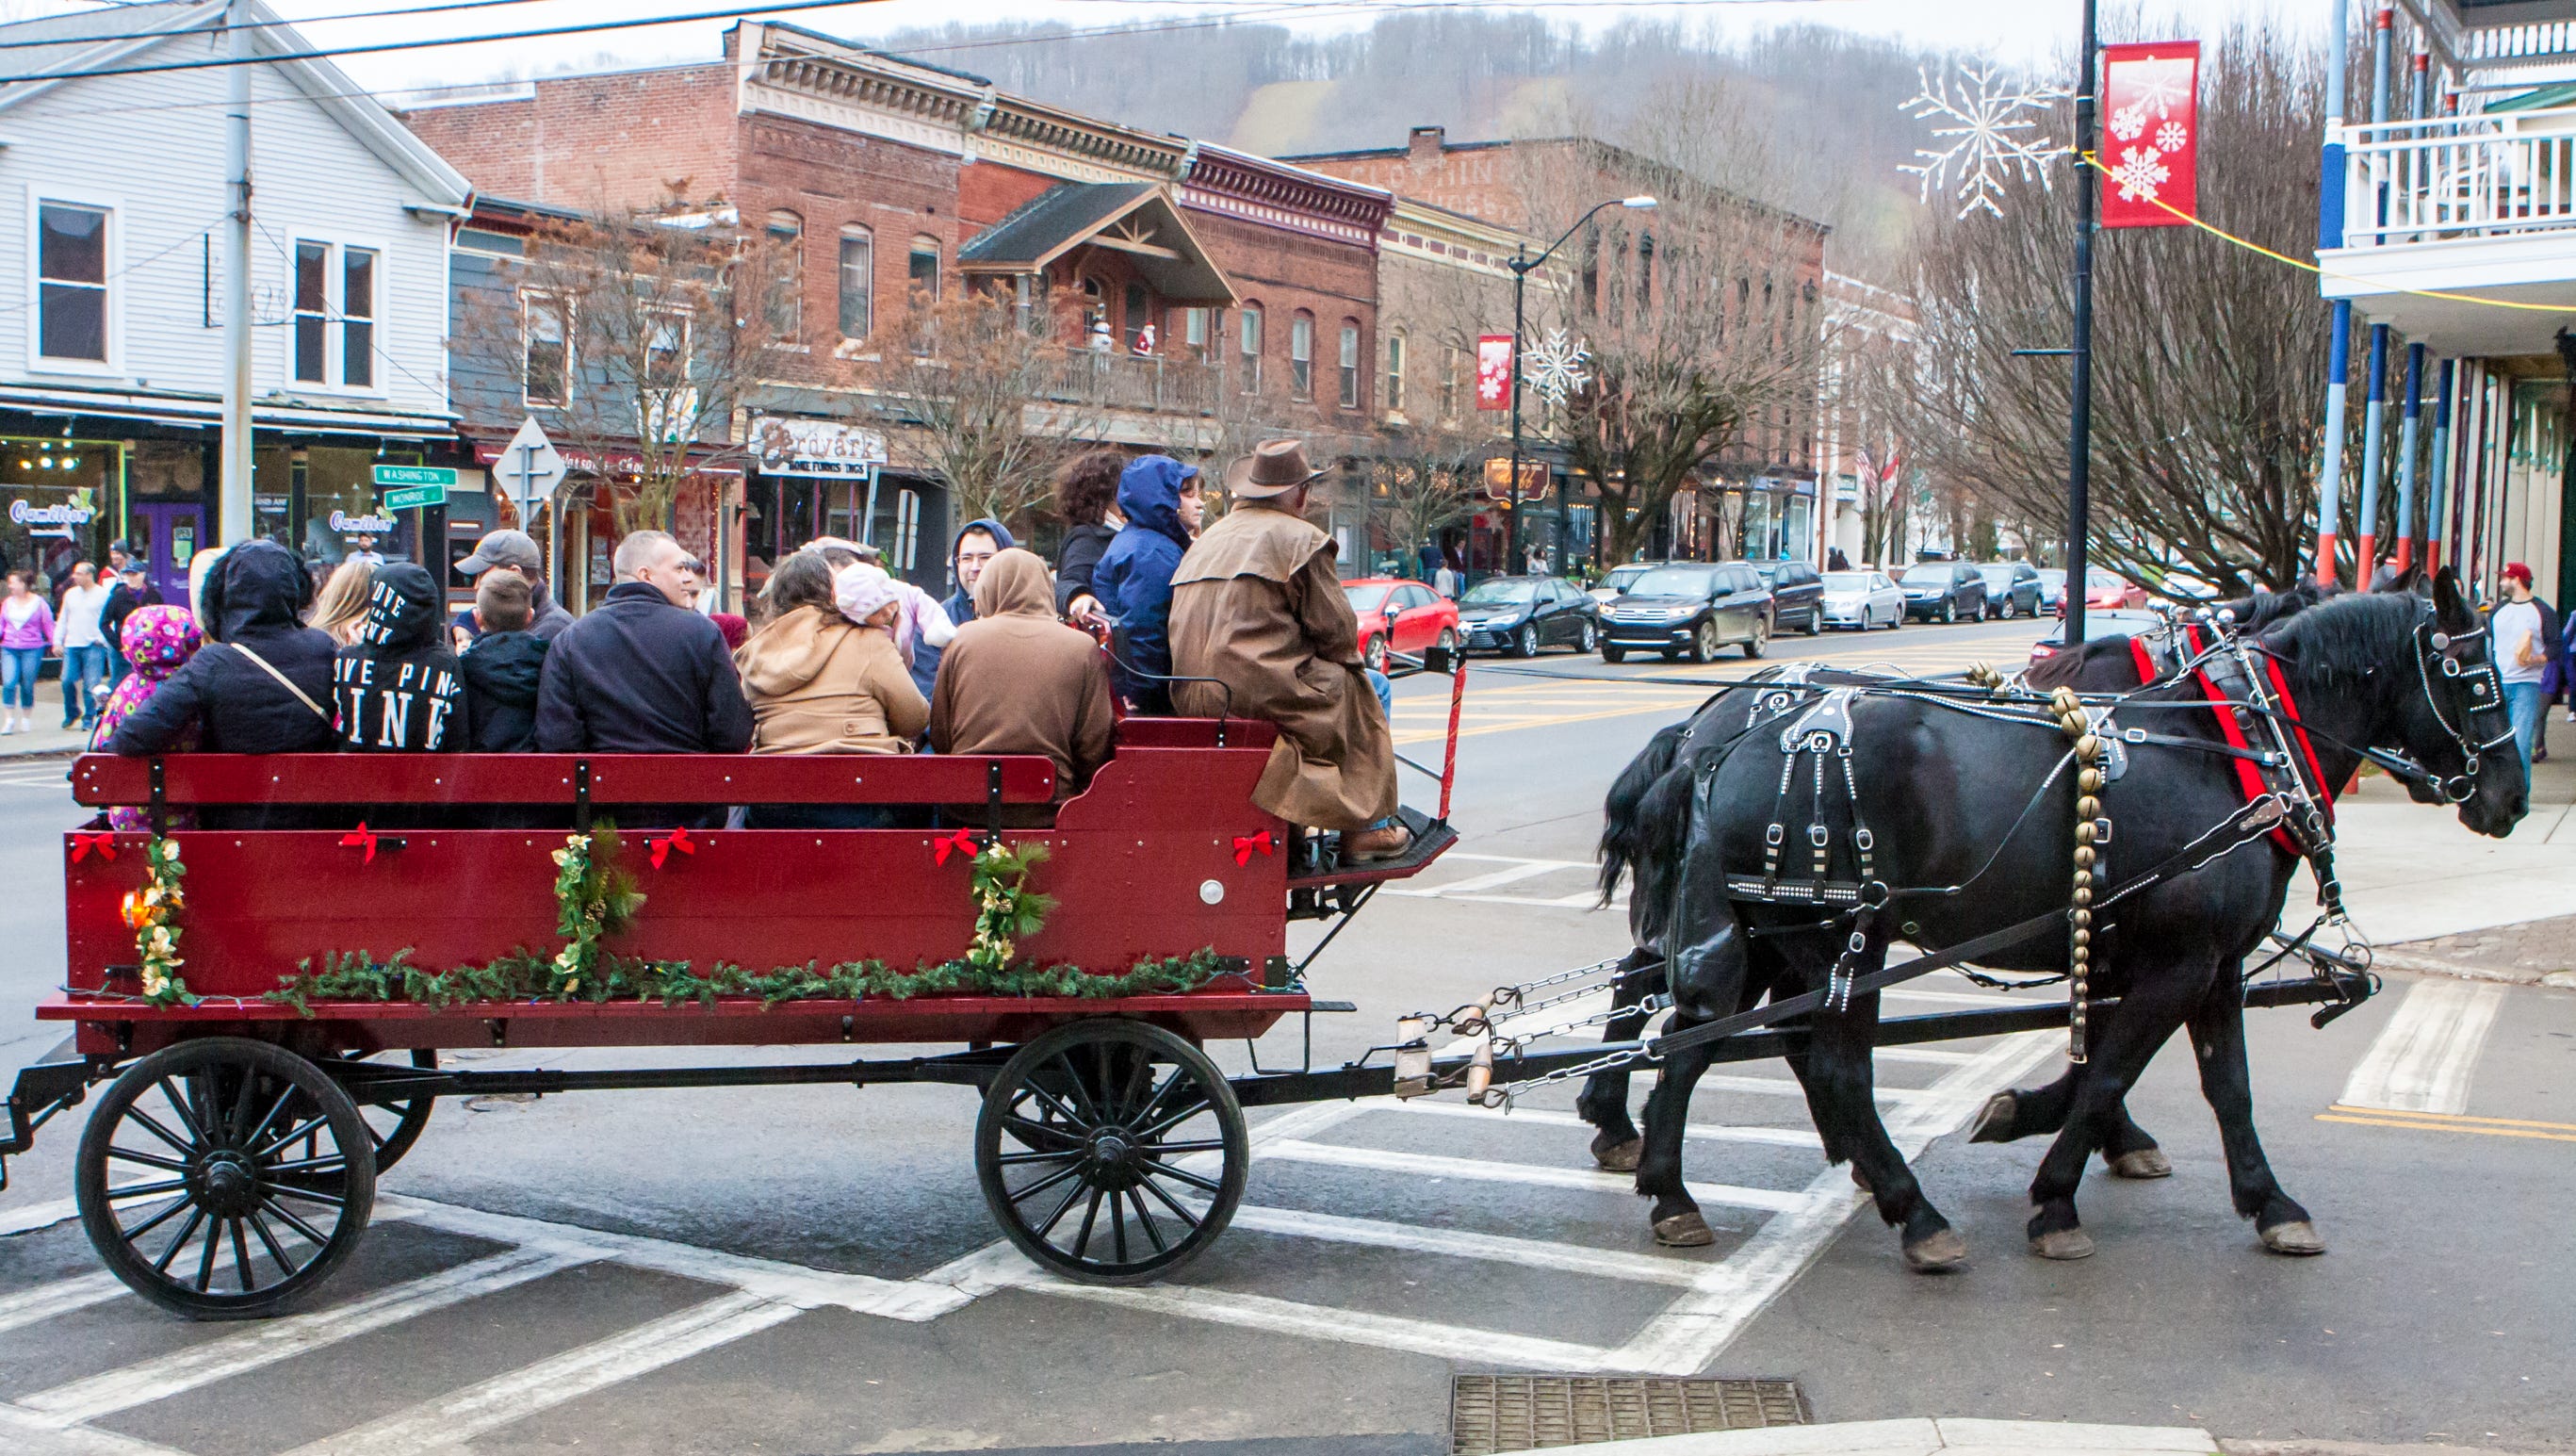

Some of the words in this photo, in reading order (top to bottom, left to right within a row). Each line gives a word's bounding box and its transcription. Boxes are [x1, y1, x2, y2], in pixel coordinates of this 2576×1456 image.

[383, 469, 440, 482] WASHINGTON
[392, 490, 426, 504] MONROE
[370, 580, 406, 618] OVE
[334, 658, 375, 685] OVE
[334, 686, 452, 750] INK
